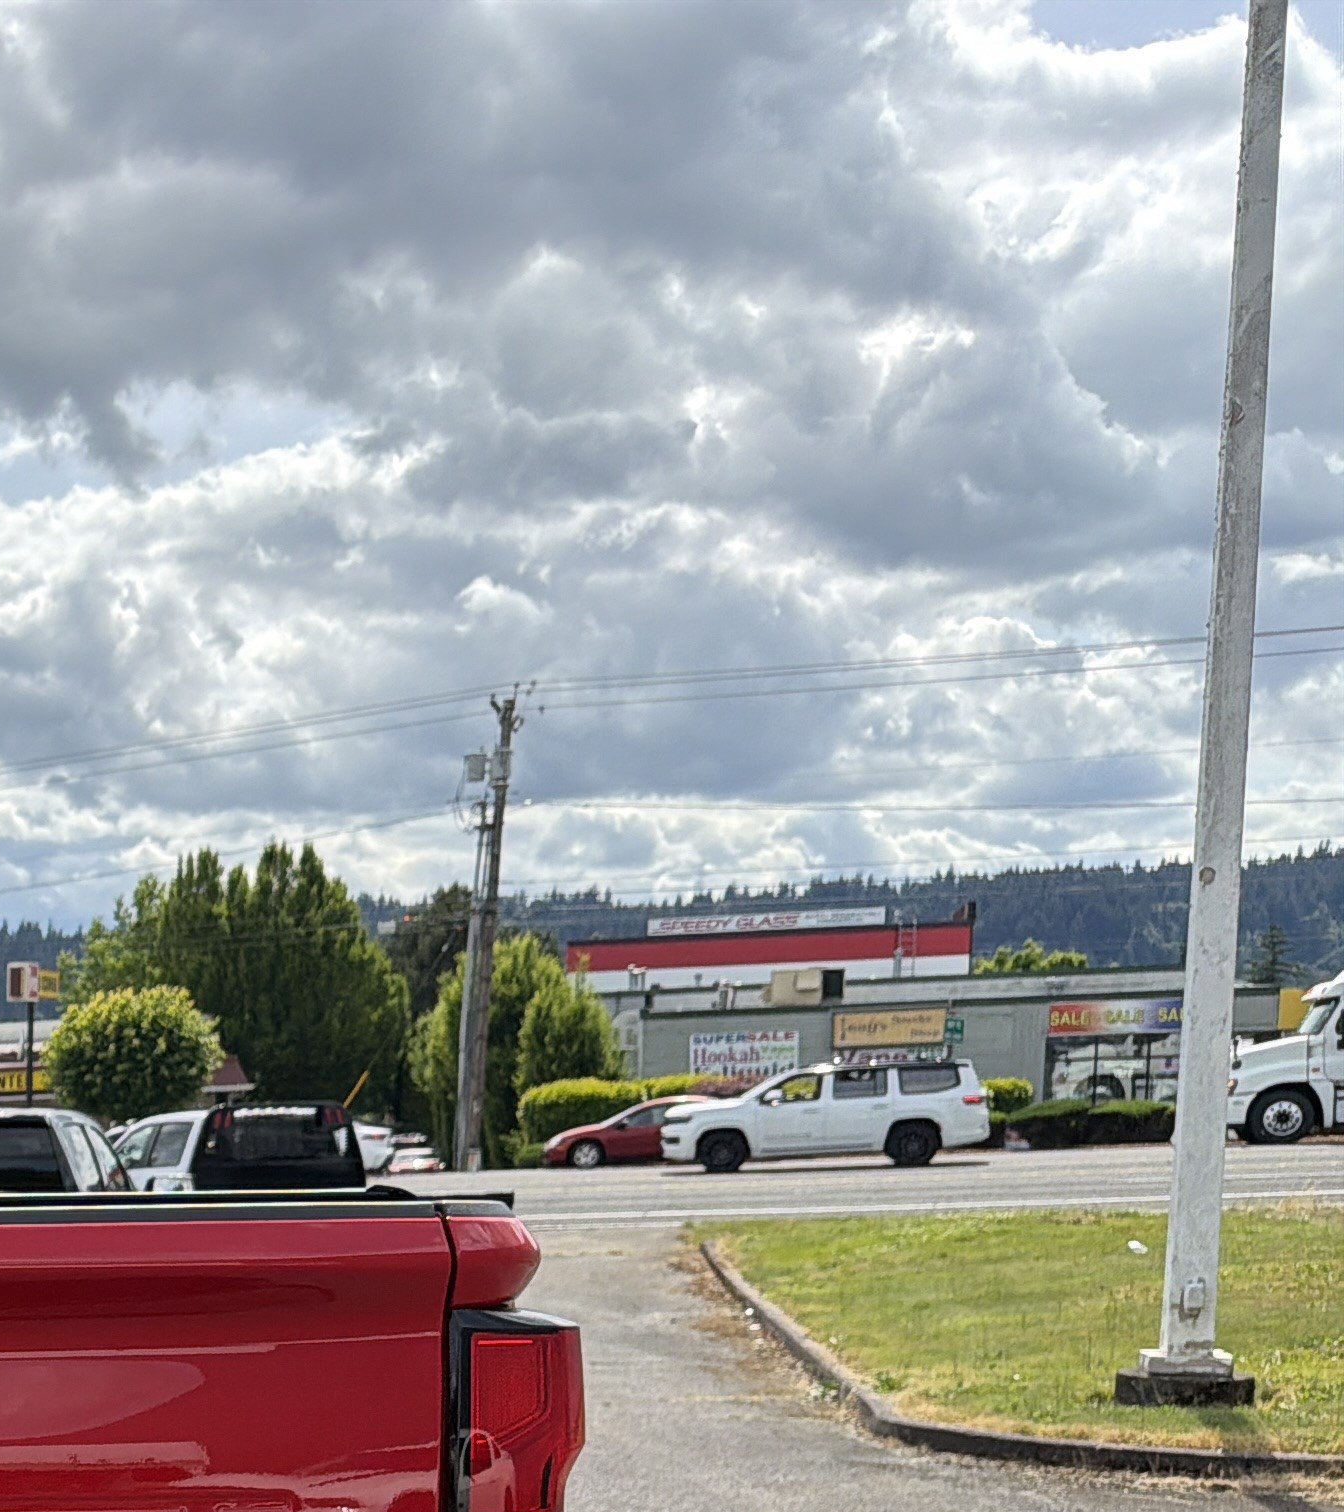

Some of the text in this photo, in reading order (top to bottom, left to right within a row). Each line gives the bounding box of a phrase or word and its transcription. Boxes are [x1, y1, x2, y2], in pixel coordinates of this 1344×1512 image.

[659, 916, 733, 933] SPEEDY
[736, 912, 800, 930] GLASS
[1050, 1010, 1090, 1027] SALE
[693, 1046, 760, 1066] Hookah
